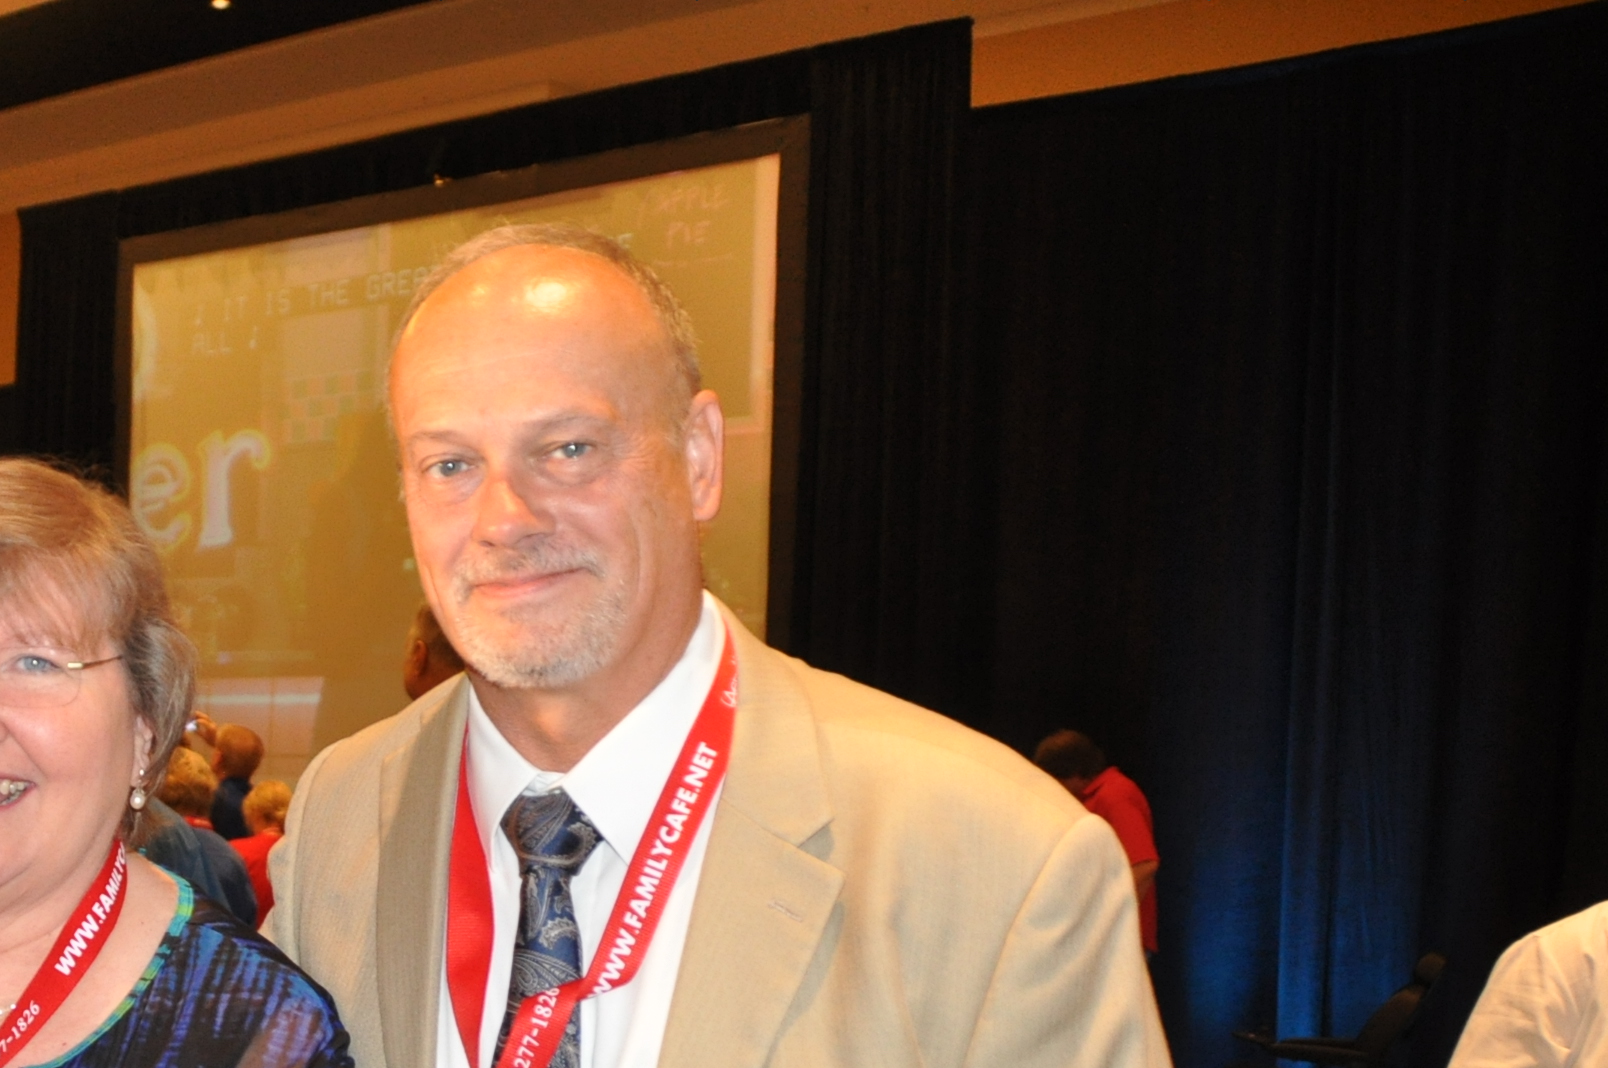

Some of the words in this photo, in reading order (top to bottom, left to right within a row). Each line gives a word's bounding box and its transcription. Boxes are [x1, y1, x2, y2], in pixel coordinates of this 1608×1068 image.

[265, 288, 290, 316] IS
[308, 278, 349, 308] THE
[366, 265, 442, 301] GREA
